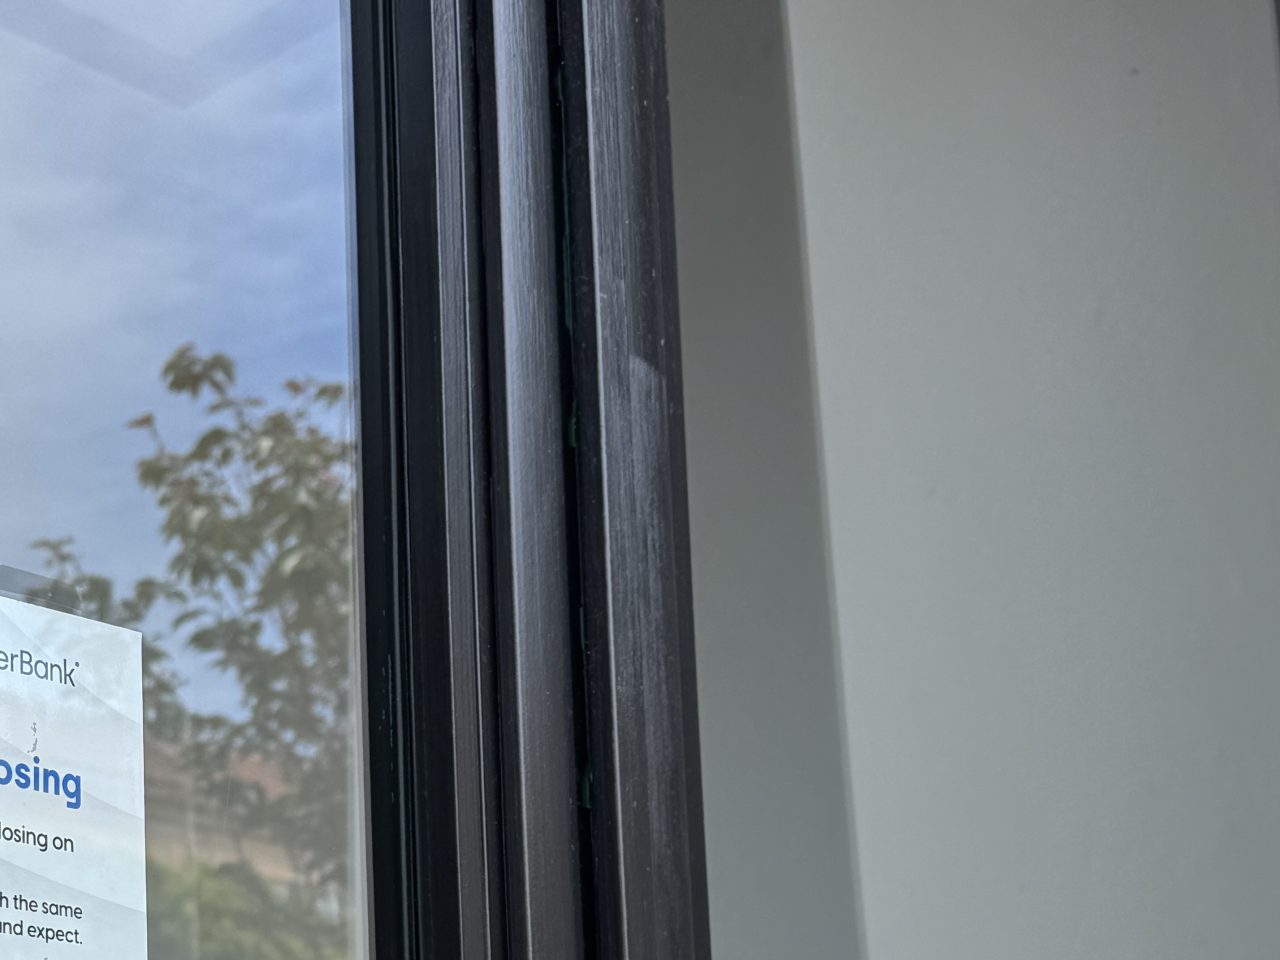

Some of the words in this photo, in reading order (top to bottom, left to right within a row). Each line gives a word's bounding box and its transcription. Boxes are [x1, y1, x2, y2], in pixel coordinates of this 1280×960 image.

[53, 837, 74, 852] on
[13, 895, 38, 912] the
[42, 902, 82, 919] same
[28, 926, 82, 944] expect.
